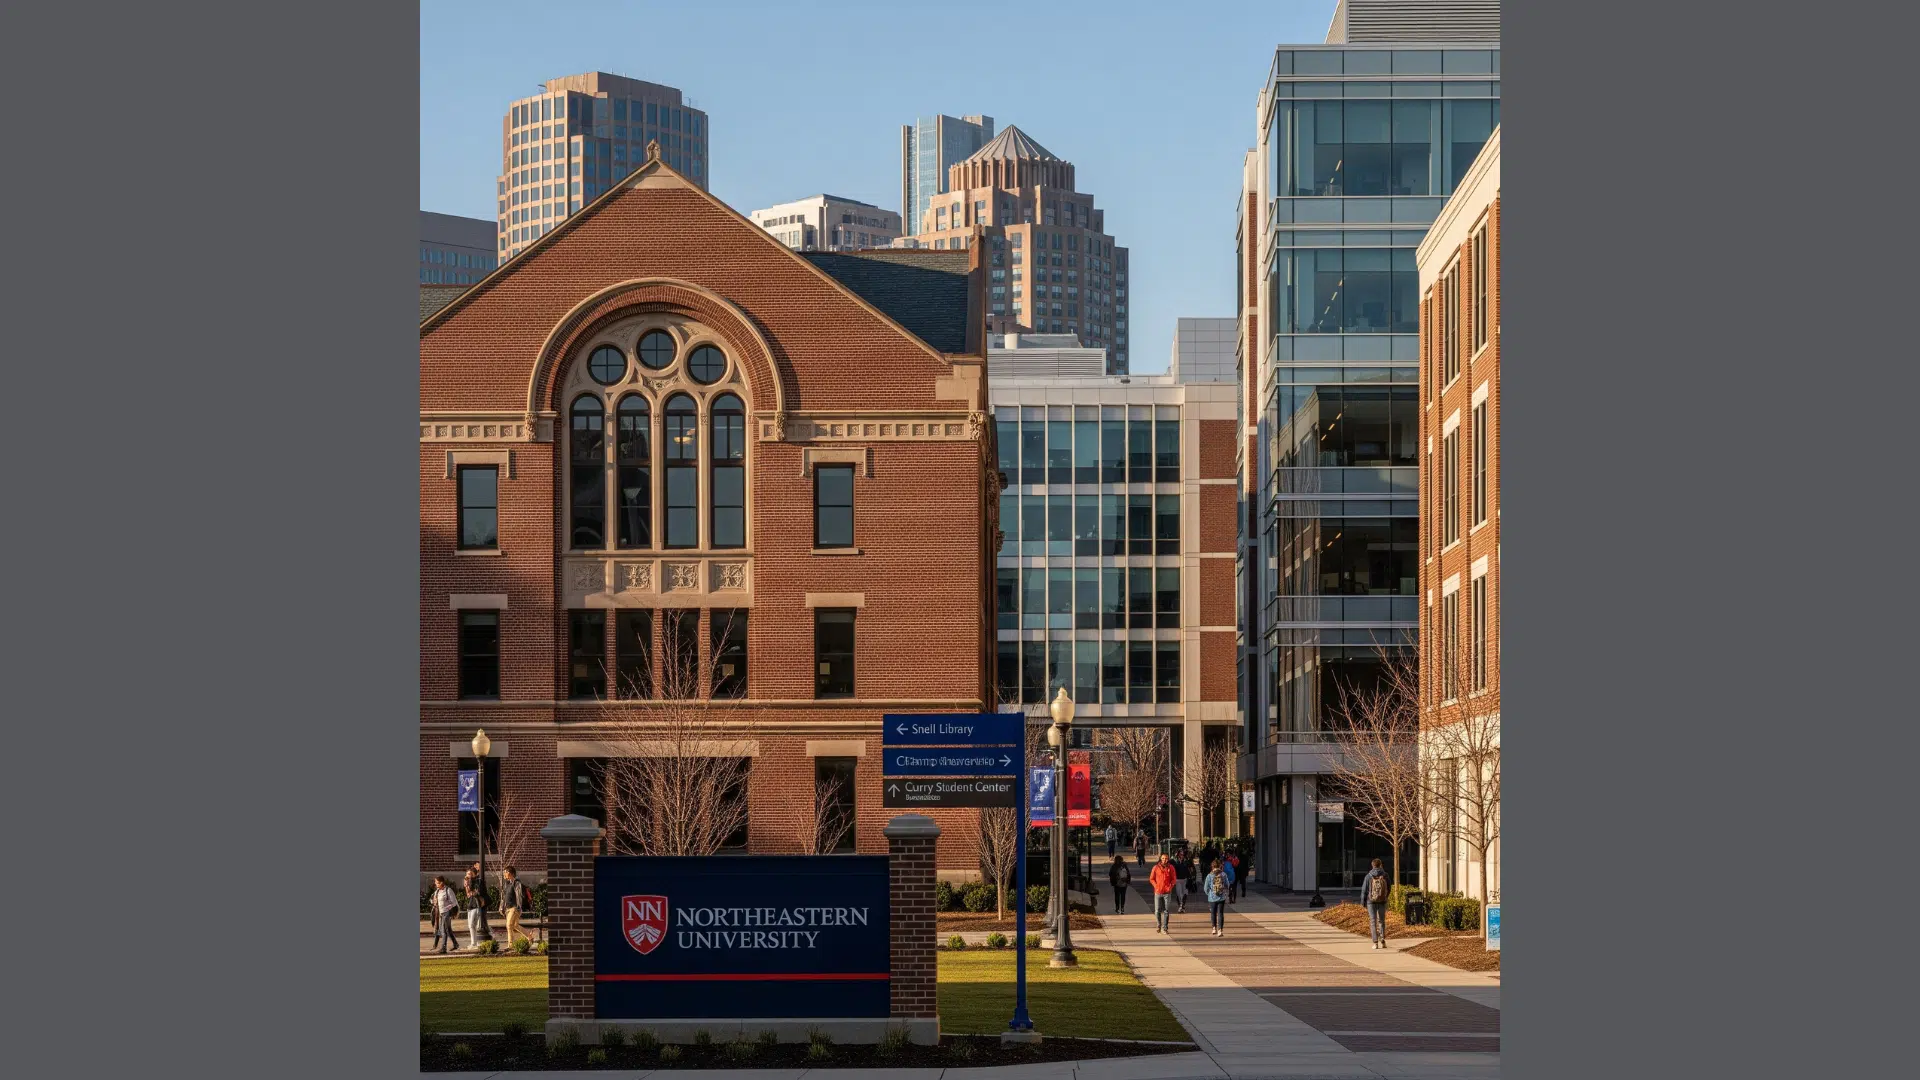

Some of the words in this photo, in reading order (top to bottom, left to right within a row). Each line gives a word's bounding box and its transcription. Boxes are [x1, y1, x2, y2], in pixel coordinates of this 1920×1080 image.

[911, 723, 936, 734] Snell
[939, 723, 974, 736] Library
[904, 781, 934, 794] Curry
[974, 781, 1011, 792] Center
[675, 906, 869, 927] NORTHEASTERN
[676, 930, 820, 949] UNIVERSITY
